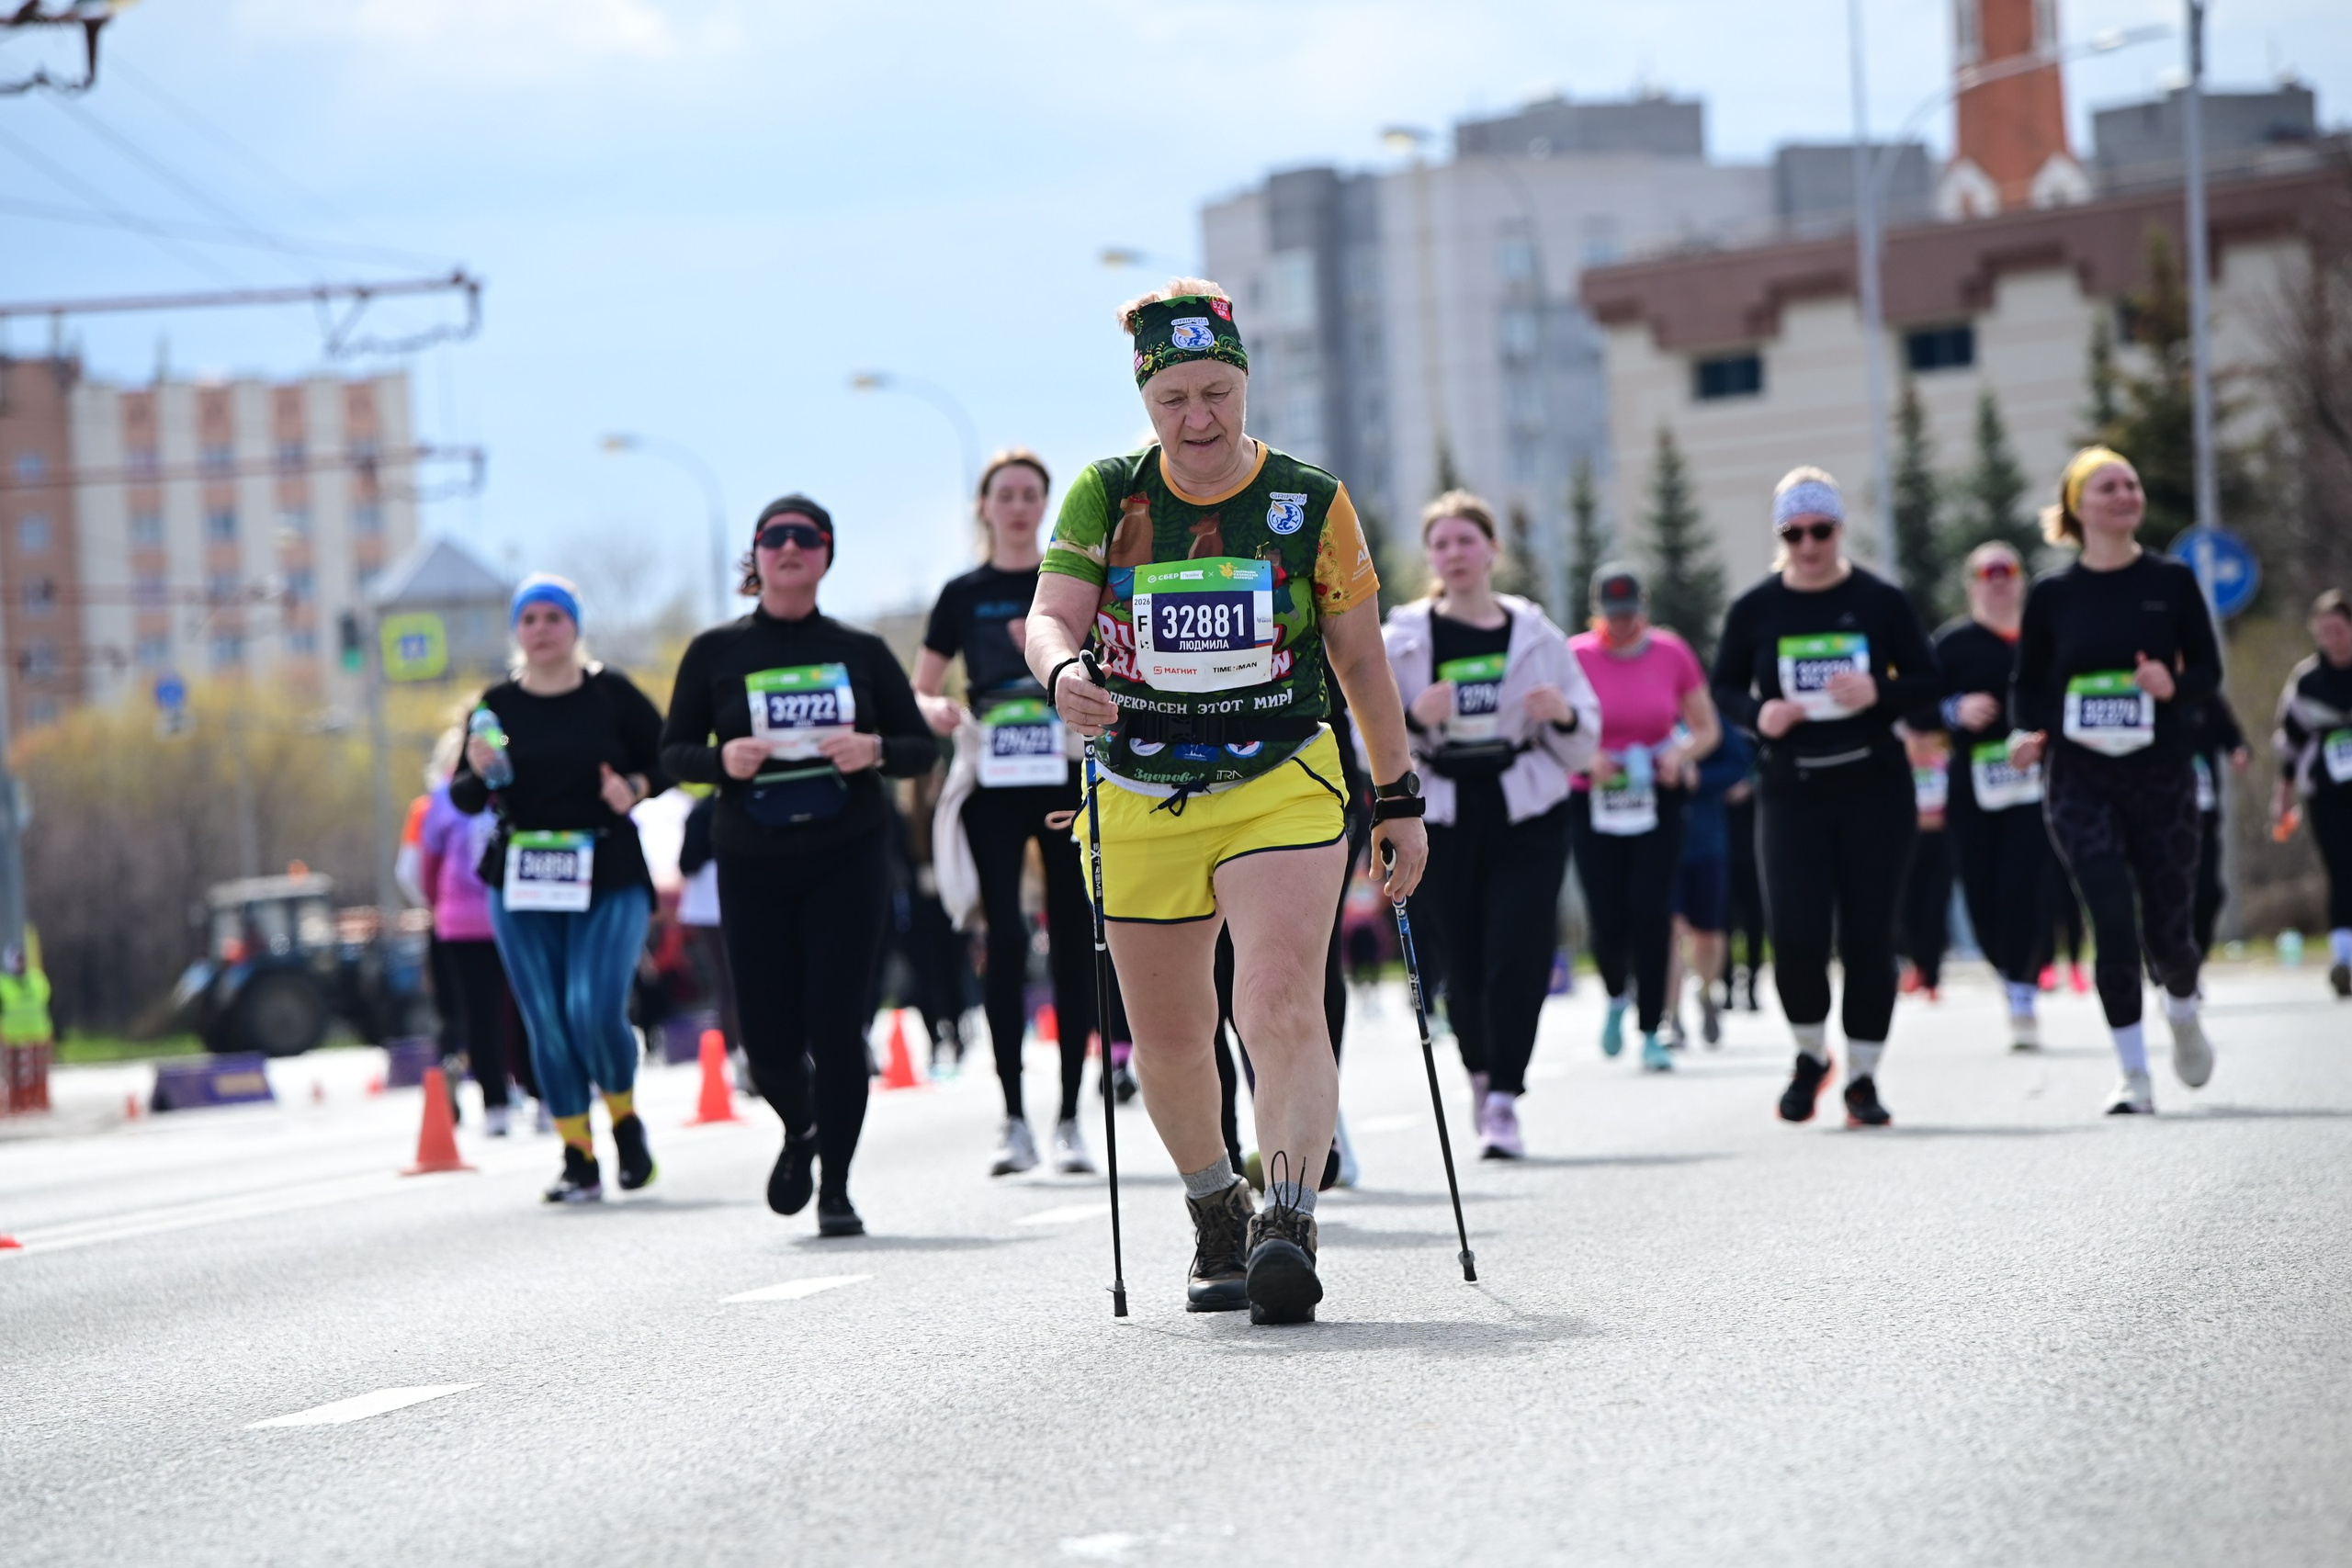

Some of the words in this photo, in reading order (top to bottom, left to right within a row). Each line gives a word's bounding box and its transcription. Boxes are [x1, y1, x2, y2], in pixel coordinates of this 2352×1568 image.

[1271, 492, 1306, 501] GRIFON
[1158, 572, 1179, 581] СБЕР
[1137, 615, 1148, 632] F
[1161, 604, 1245, 638] 32881
[1179, 639, 1229, 651] ЛЮДМИЛА
[1164, 667, 1198, 675] МАГНИТ
[770, 693, 837, 722] 32722
[1110, 691, 1188, 715] ПРЕКРАСЕН
[1197, 698, 1244, 715] ЭТОТ
[1253, 688, 1294, 710] МИР!
[1090, 841, 1102, 898] EXTREME
